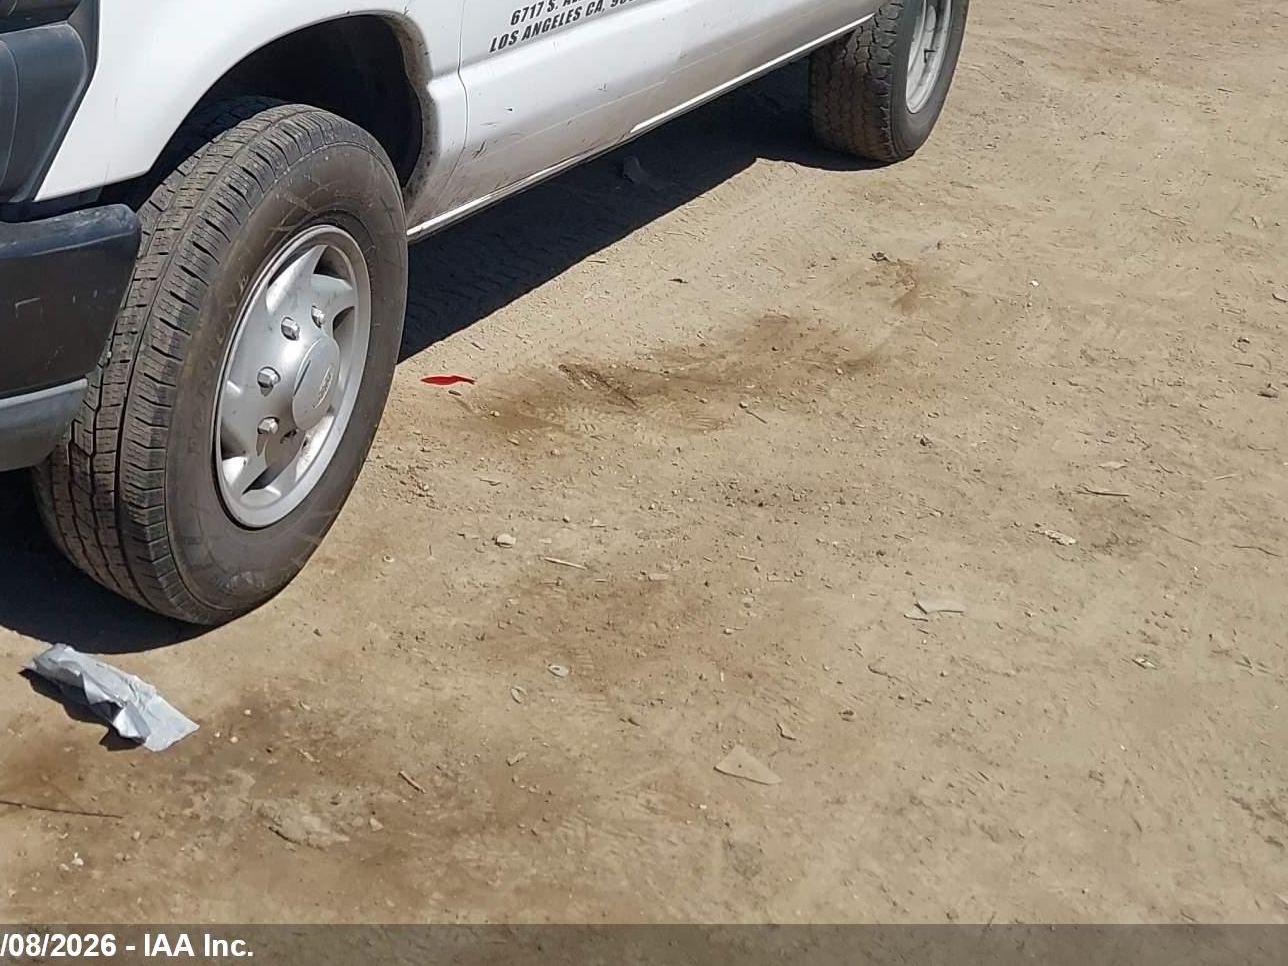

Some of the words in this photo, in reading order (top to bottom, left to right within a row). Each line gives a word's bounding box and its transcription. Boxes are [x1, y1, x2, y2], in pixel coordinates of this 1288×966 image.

[489, 30, 519, 53] LOS
[521, 6, 582, 41] ANGELES
[510, 1, 544, 26] 6717
